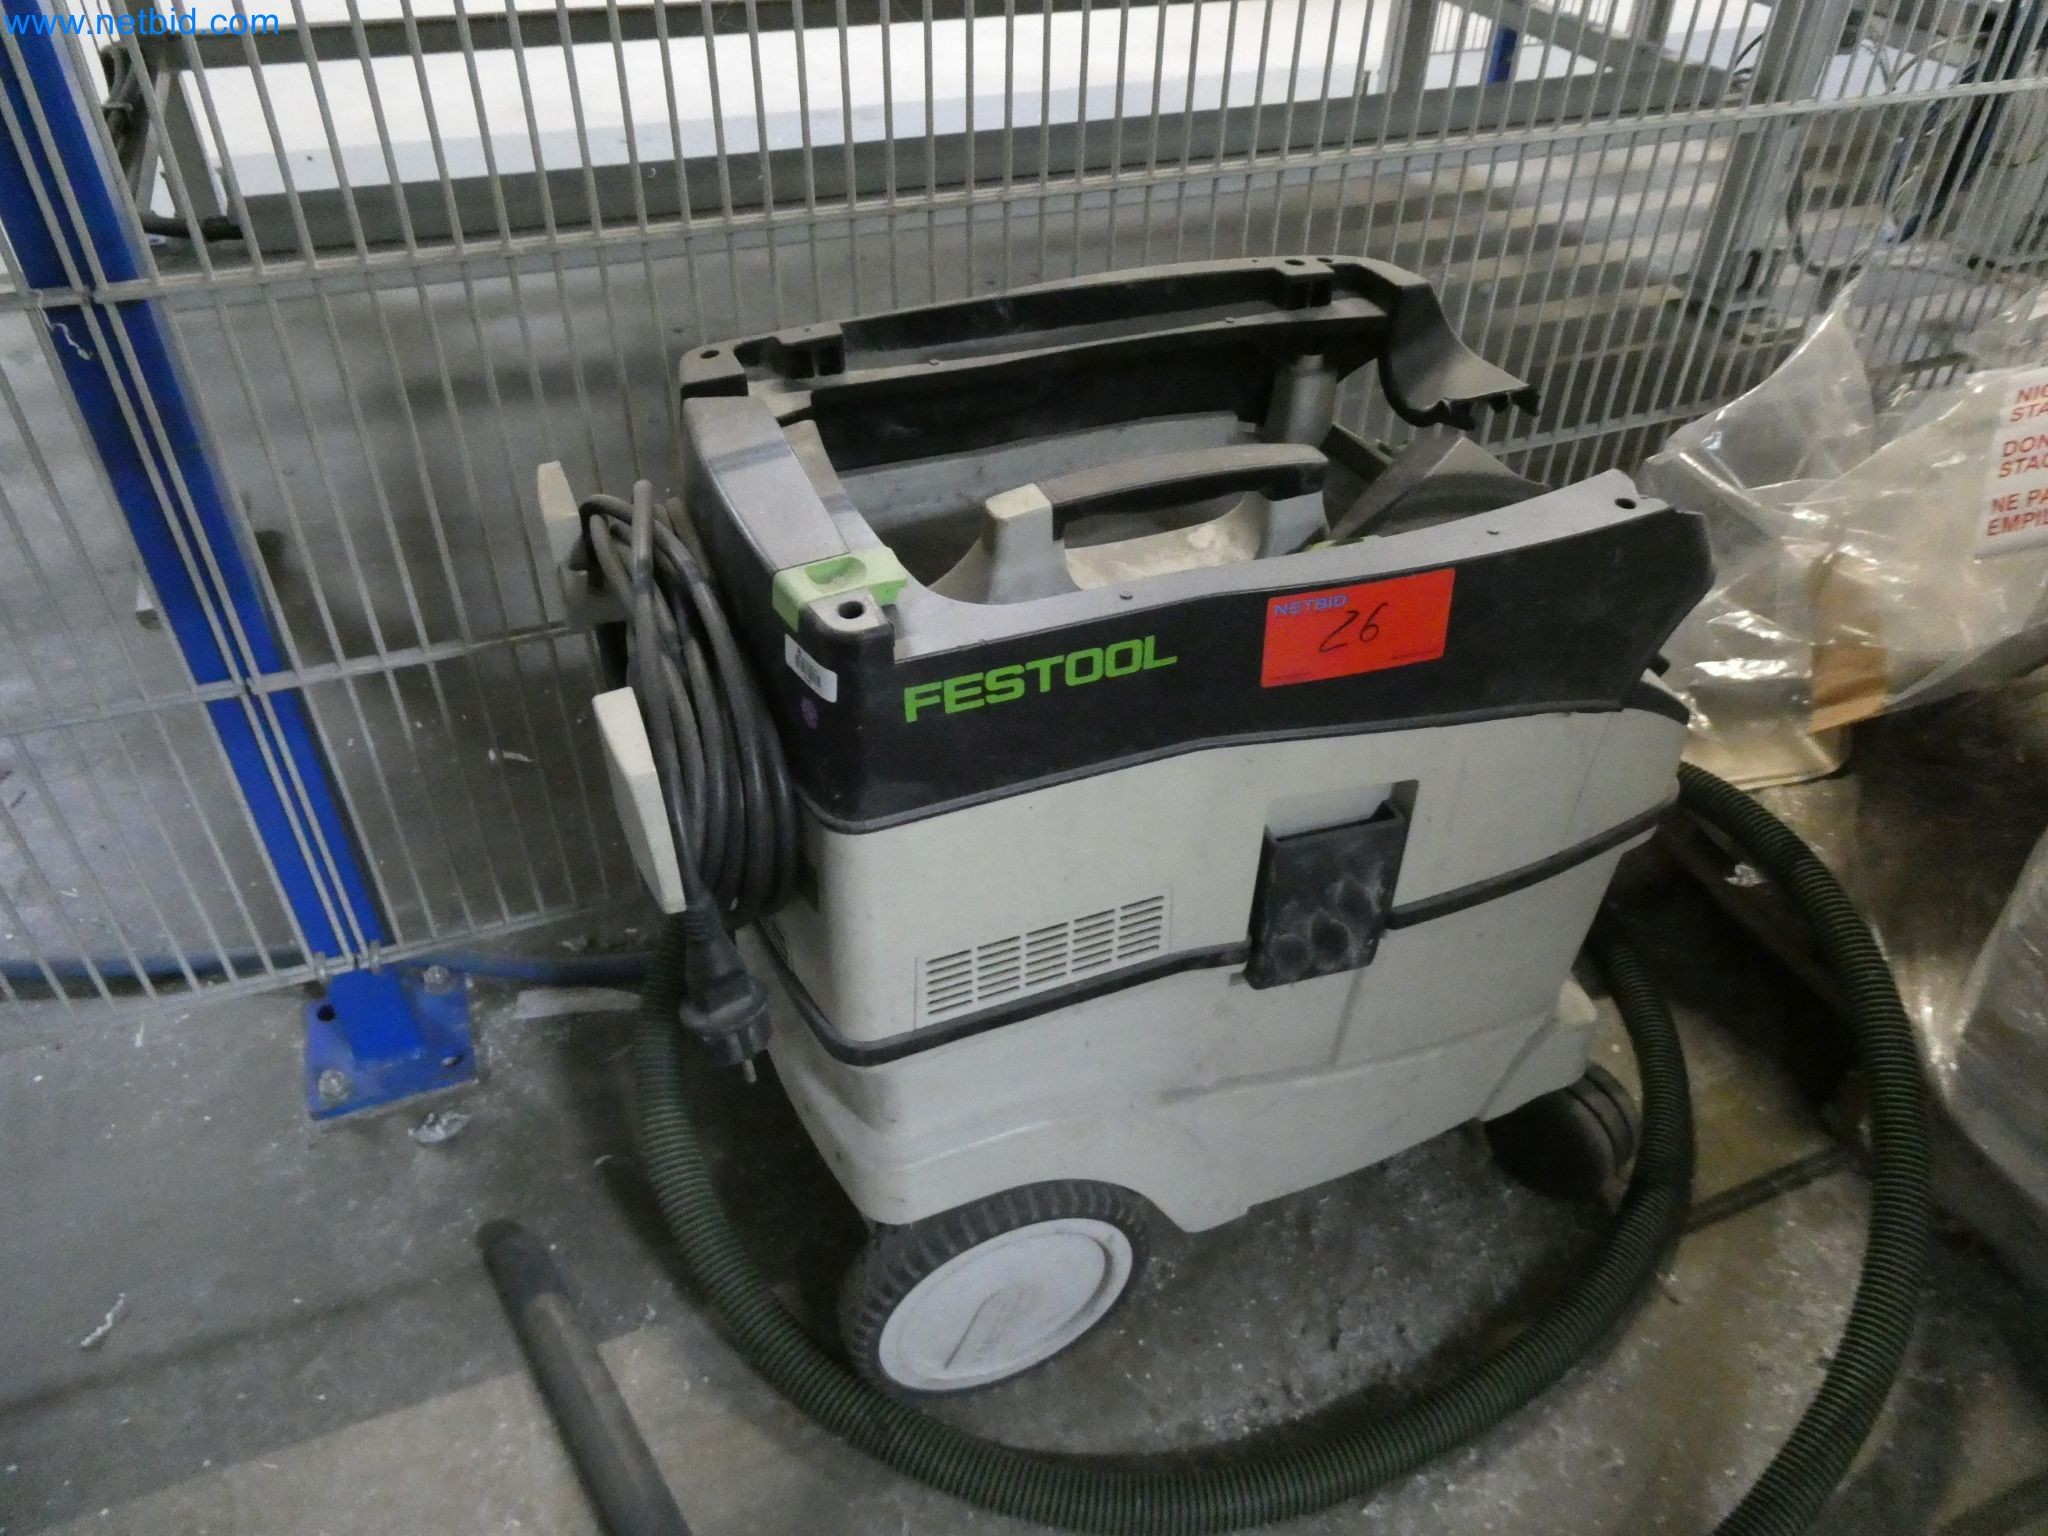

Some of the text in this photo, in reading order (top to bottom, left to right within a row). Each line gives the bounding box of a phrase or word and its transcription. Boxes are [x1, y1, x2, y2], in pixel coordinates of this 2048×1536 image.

[1992, 492, 2020, 512] NE
[1274, 594, 1349, 616] NETBID
[1318, 602, 1388, 653] 26
[904, 635, 1178, 723] FESTOOL
